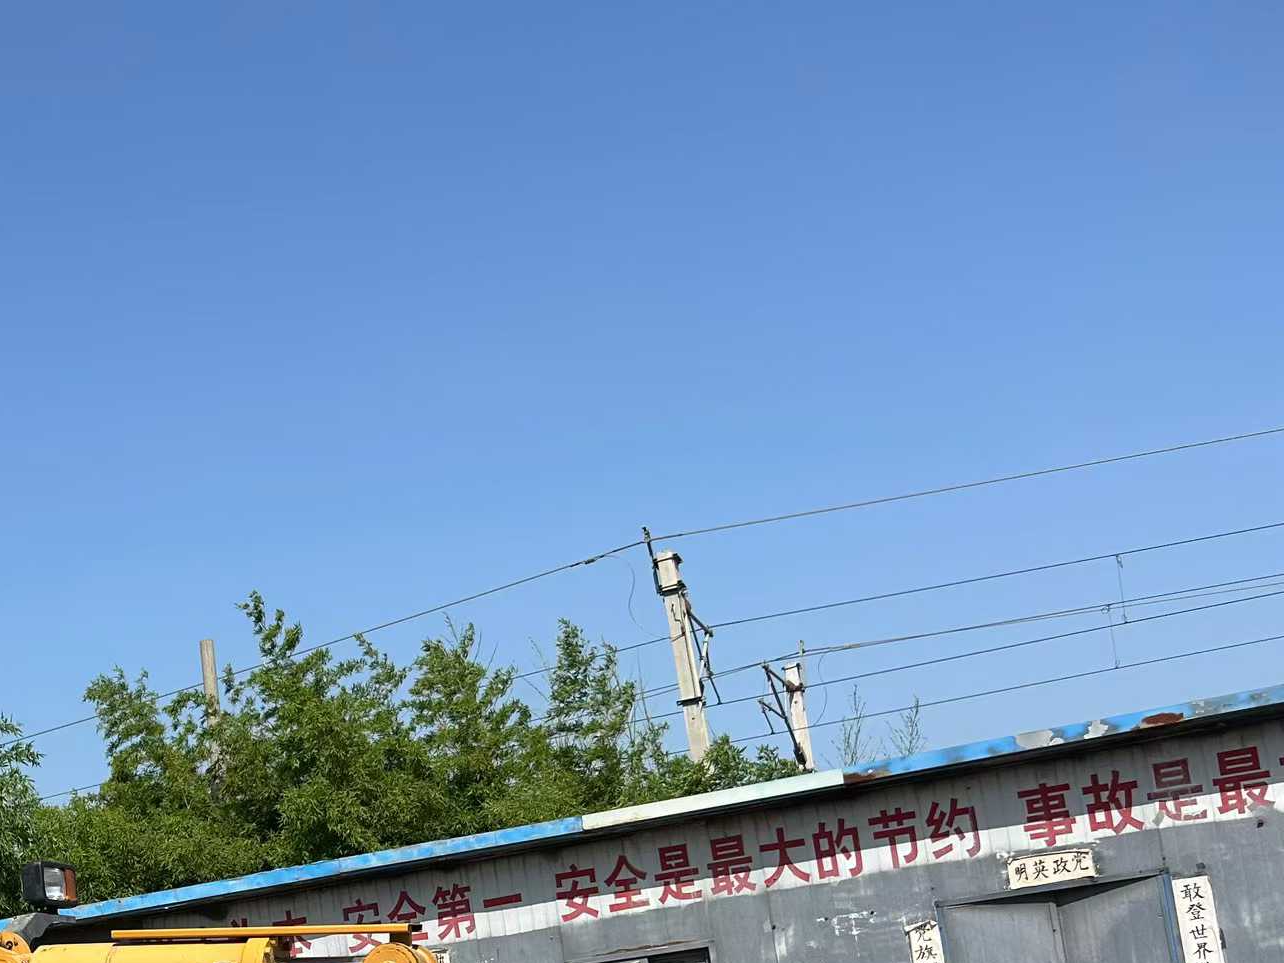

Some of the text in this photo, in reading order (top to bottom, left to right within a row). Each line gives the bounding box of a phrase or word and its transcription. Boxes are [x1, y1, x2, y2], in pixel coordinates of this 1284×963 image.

[342, 883, 522, 953] 安全第一
[555, 798, 981, 922] 安全是最大的节约
[1017, 746, 1284, 847] 事故是最
